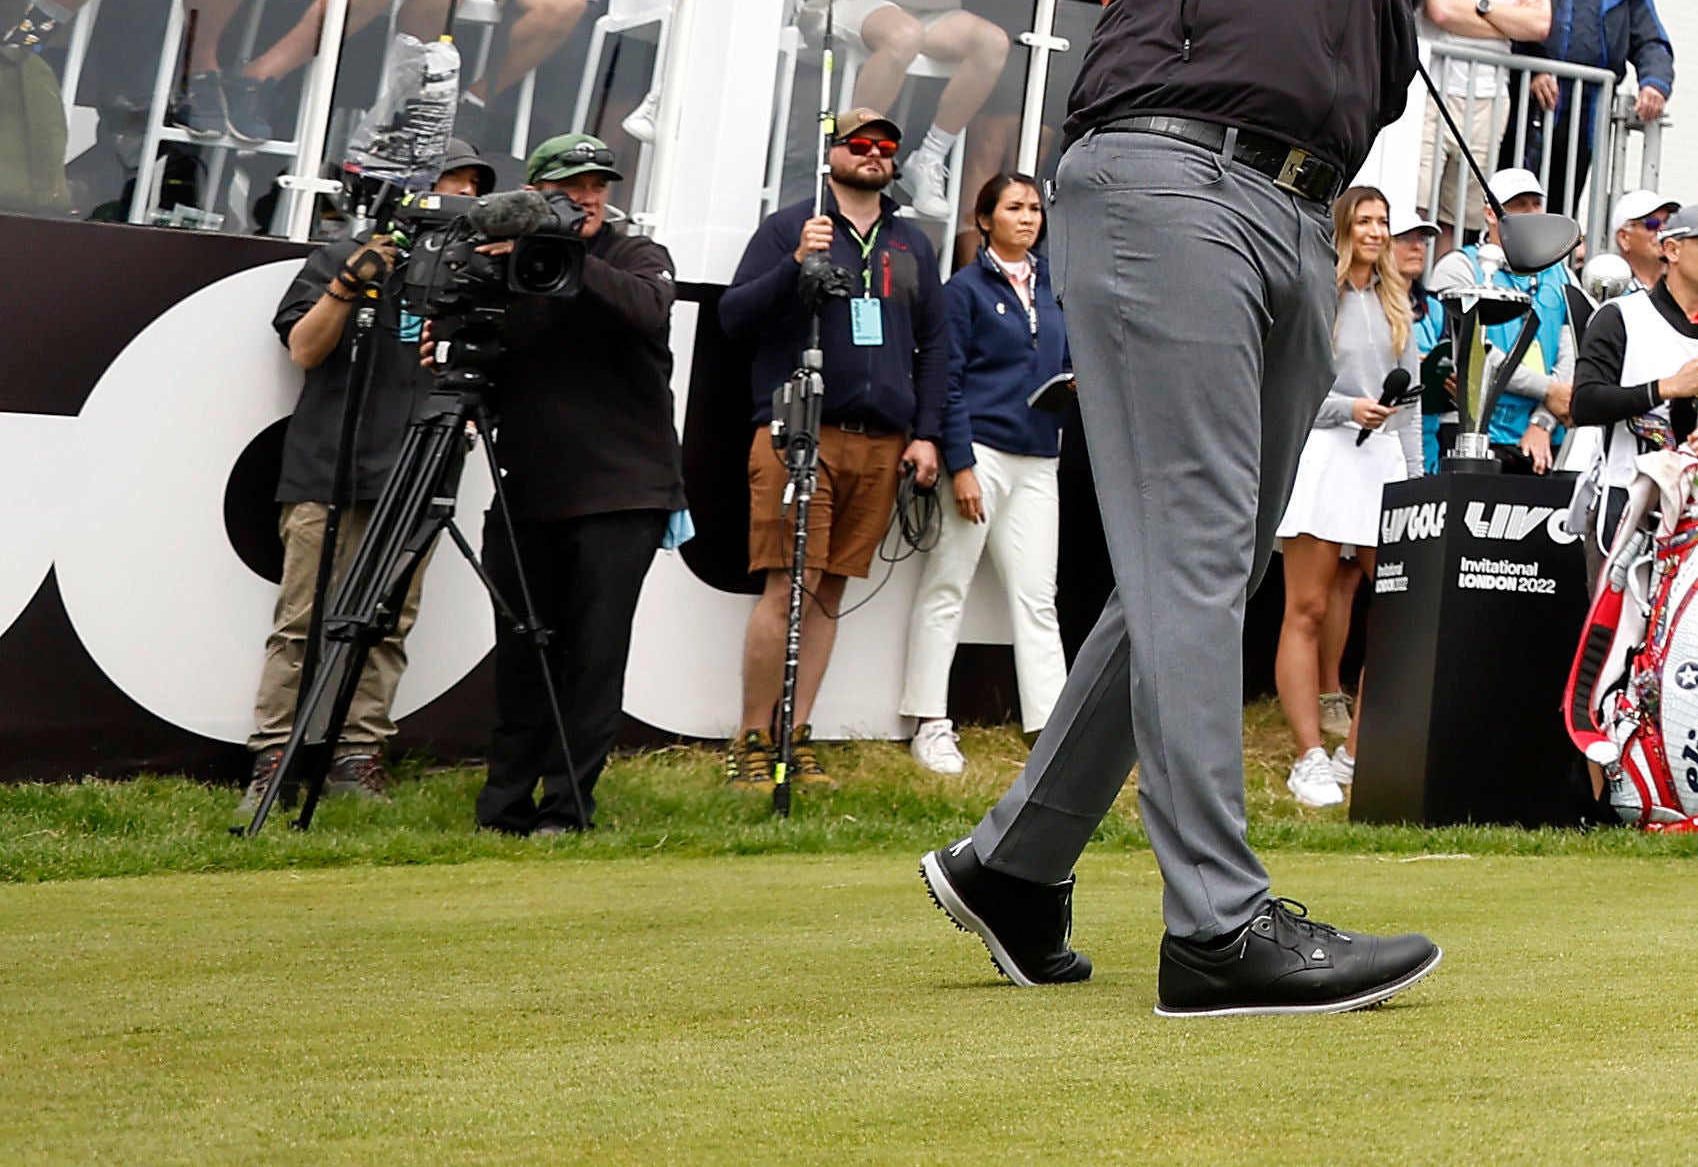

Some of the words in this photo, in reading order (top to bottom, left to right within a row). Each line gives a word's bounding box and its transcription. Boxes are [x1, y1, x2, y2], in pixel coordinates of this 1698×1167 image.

[1460, 556, 1539, 577] Invitational
[1458, 572, 1517, 592] LONDON
[1518, 576, 1557, 595] 2022
